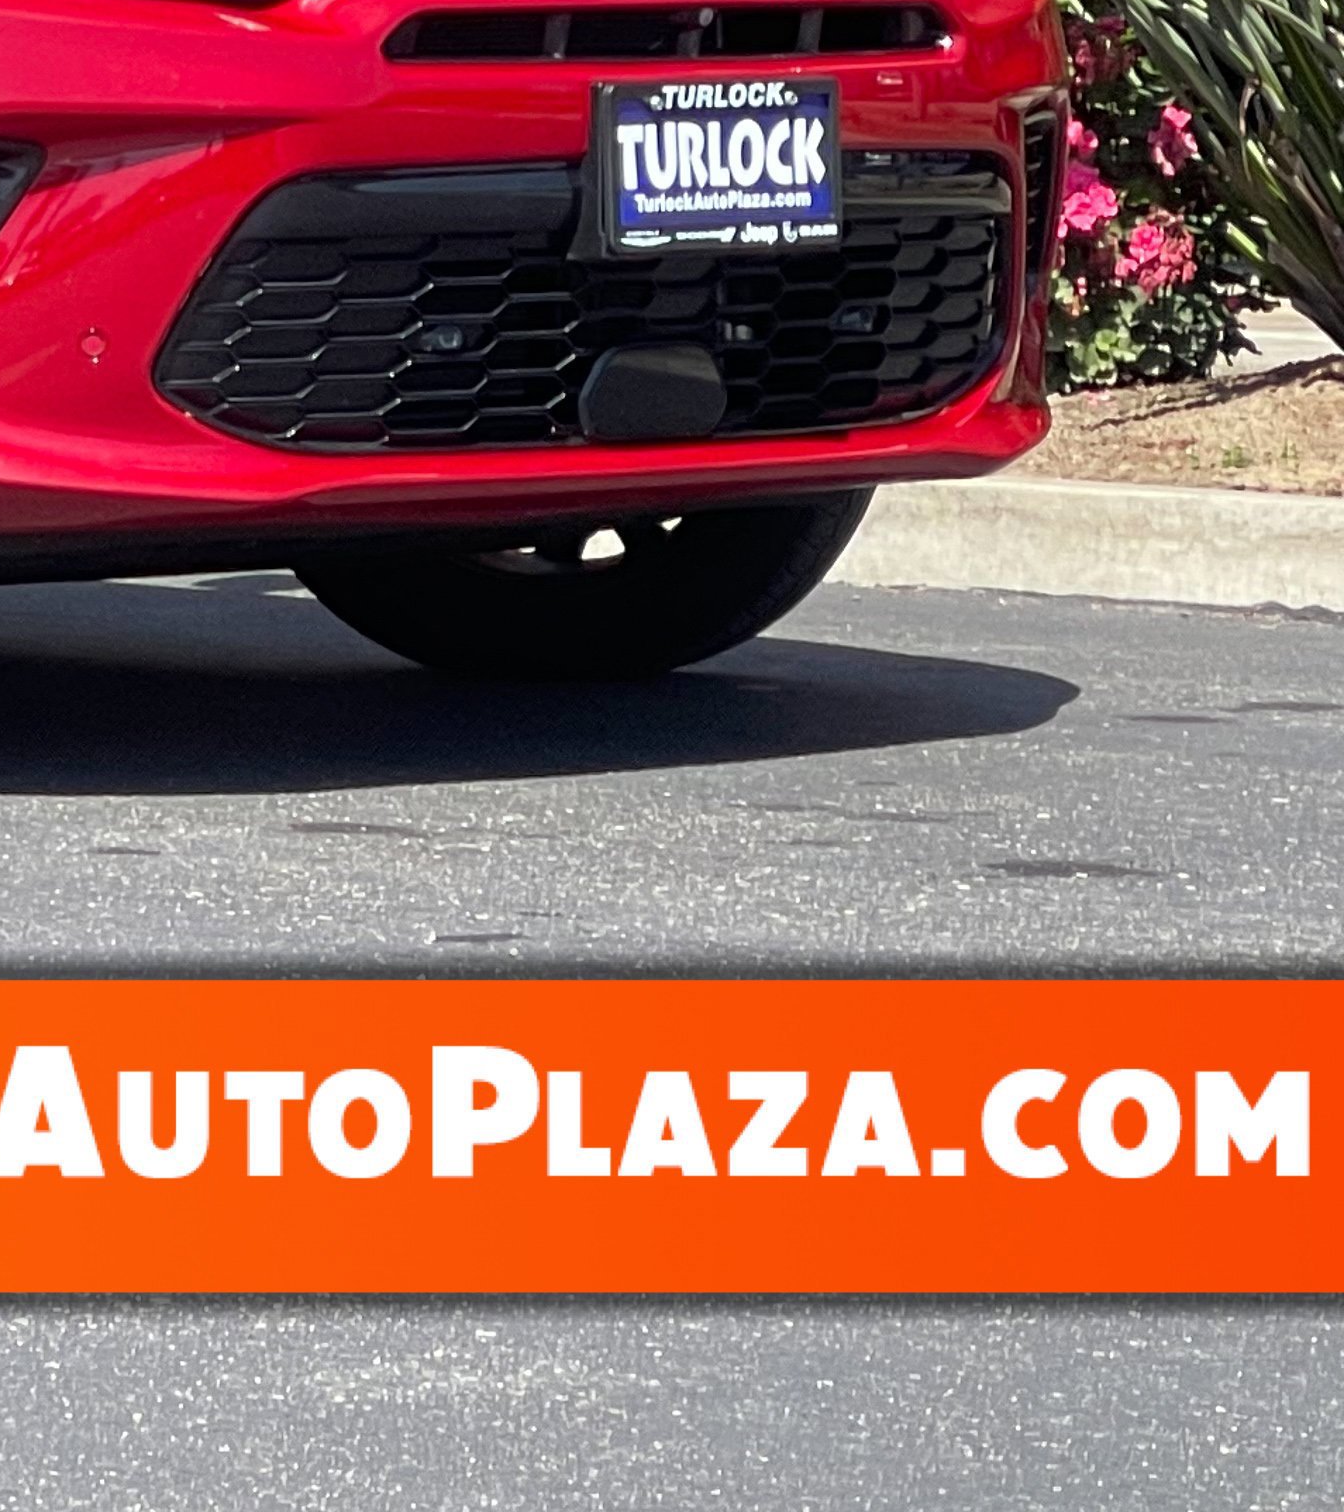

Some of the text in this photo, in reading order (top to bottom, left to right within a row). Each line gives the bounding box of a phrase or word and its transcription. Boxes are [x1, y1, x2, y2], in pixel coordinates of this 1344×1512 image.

[662, 82, 786, 110] TURLOCK
[616, 117, 827, 191] TURLOCK
[633, 190, 812, 214] TurlockAutoPlaza.com
